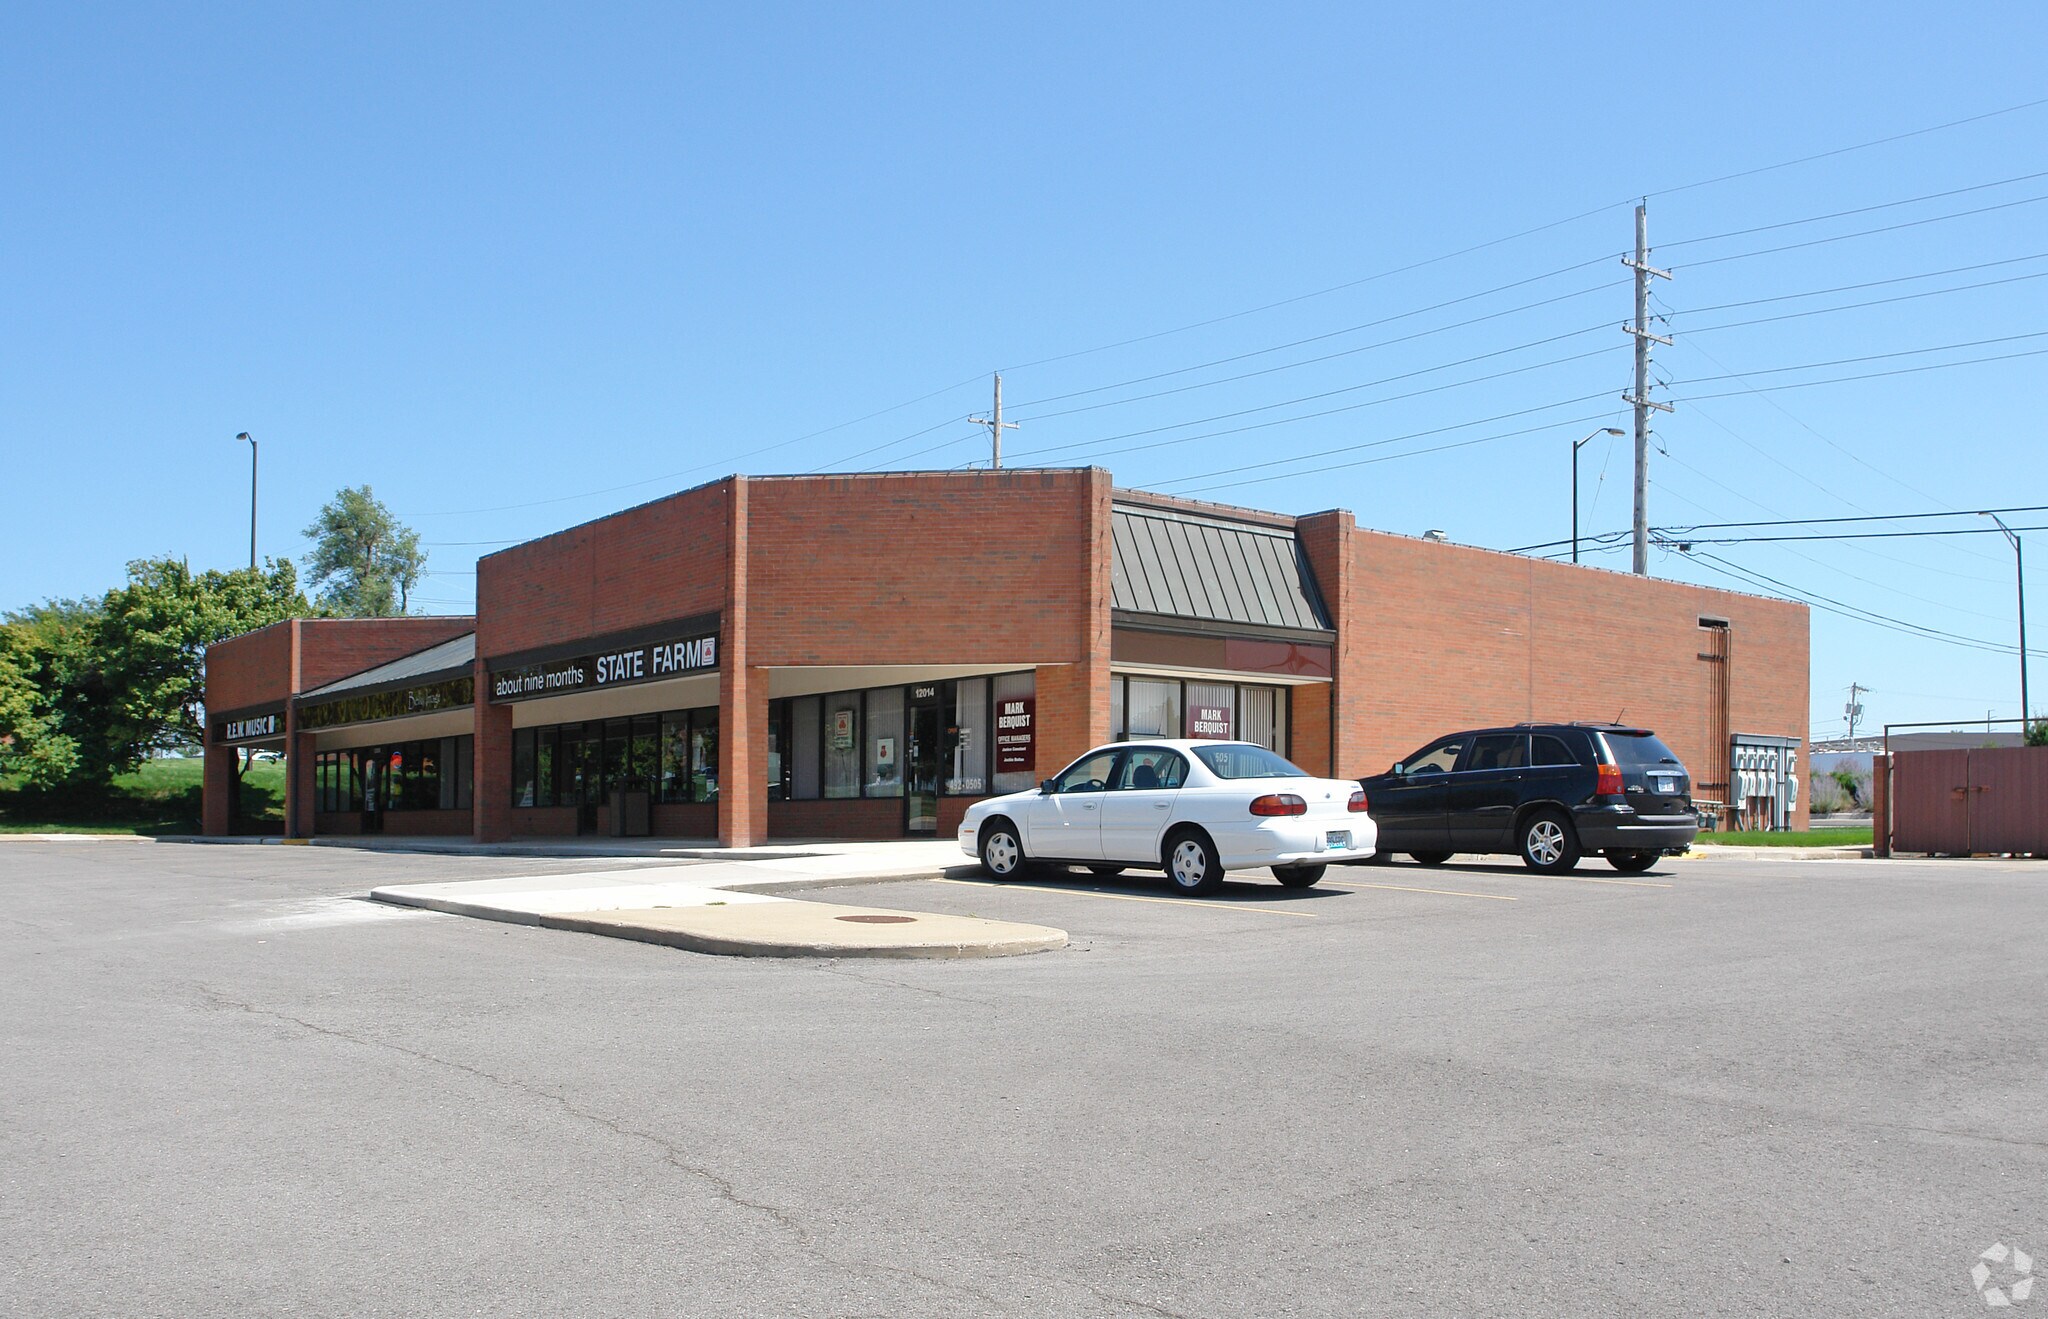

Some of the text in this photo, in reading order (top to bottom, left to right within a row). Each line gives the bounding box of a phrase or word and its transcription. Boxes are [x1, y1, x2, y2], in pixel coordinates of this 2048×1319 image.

[597, 650, 644, 684] STATE
[653, 639, 701, 674] FARM
[496, 665, 584, 696] about nine months
[915, 687, 935, 698] 12014
[1004, 701, 1025, 715] MARK
[1201, 708, 1222, 721] MARK
[245, 716, 268, 737] MUSIC
[998, 714, 1031, 729] BERQUIST
[1194, 721, 1229, 735] BERQUIST
